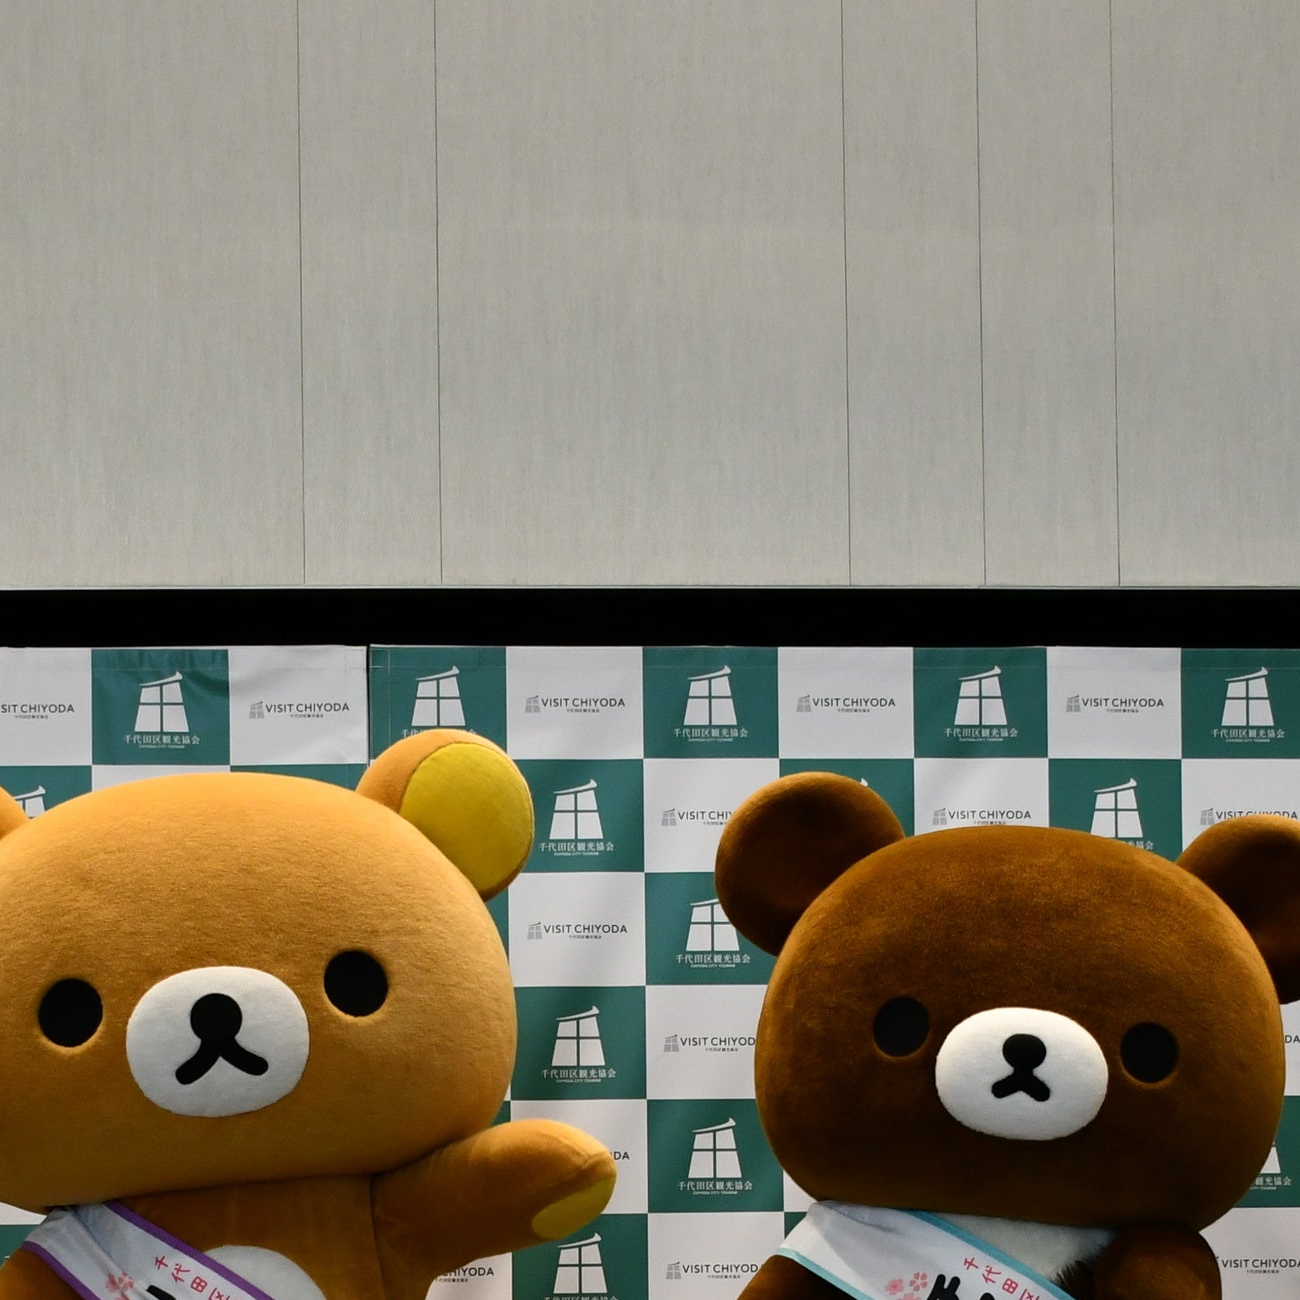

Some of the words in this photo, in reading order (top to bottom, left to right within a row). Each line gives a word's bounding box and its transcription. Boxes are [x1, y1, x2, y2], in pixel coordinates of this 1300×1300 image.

[266, 703, 294, 713] VISIT
[296, 702, 350, 713] CHIYODA
[541, 698, 569, 708] VISIT
[571, 697, 625, 708] CHIYODA
[812, 698, 840, 708] VISIT
[842, 697, 895, 708] CHIYODA
[1081, 698, 1109, 708] VISIT
[1111, 698, 1164, 708] CHIYODA
[20, 703, 75, 714] CHIYODA
[678, 810, 706, 820] VISIT
[948, 809, 977, 820] VISIT
[979, 809, 1031, 820] CHIYODA
[544, 924, 572, 934] VISIT
[574, 923, 627, 934] CHIYODA
[680, 1037, 708, 1047] VISIT
[710, 1036, 756, 1047] CHIYOD
[683, 1264, 710, 1274] VISIT
[712, 1263, 758, 1274] CHIYOD
[1221, 1258, 1249, 1268] VISIT
